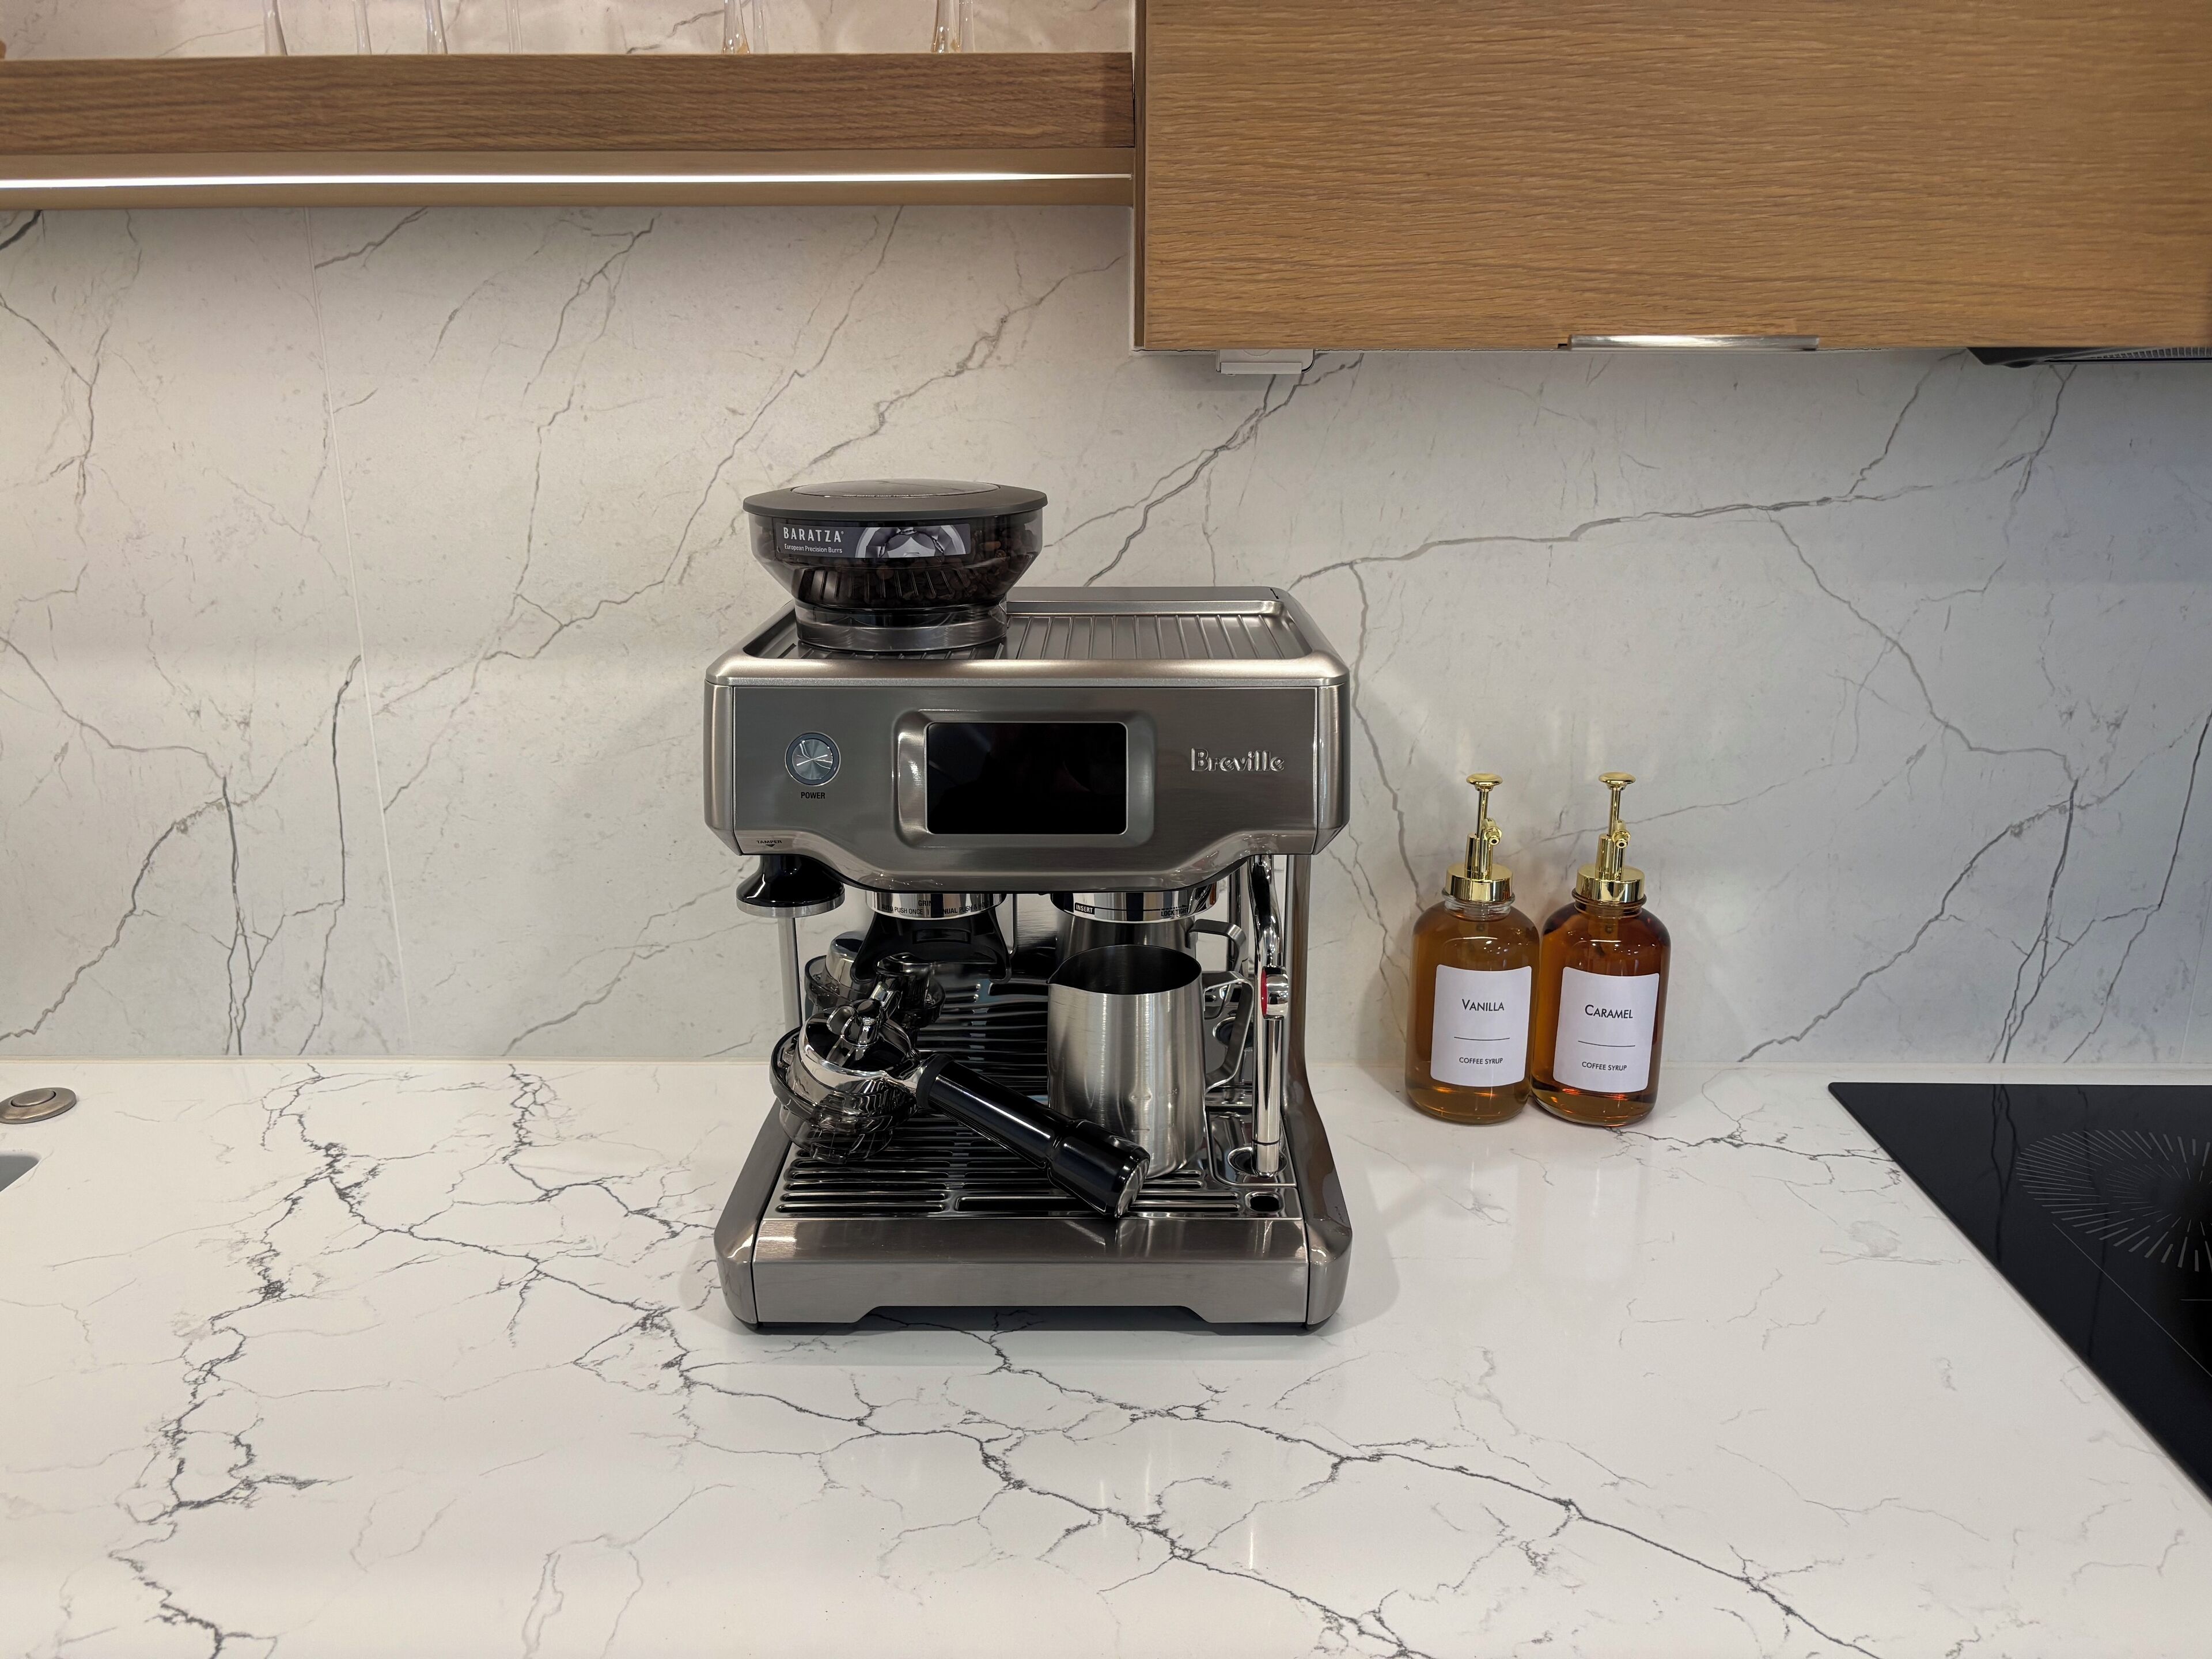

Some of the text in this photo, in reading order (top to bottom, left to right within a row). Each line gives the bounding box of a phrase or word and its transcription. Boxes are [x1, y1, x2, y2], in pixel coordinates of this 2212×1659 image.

[784, 543, 804, 551] European
[1191, 748, 1285, 772] Breville
[800, 791, 825, 800] POWER
[881, 904, 893, 912] AUTO
[894, 906, 908, 914] PUSH
[959, 904, 972, 913] PUSH
[1075, 904, 1093, 914] INSERT
[1461, 998, 1505, 1012] VANILLA
[1585, 1004, 1633, 1019] CARAMEL
[1582, 1062, 1607, 1070] COFFEE
